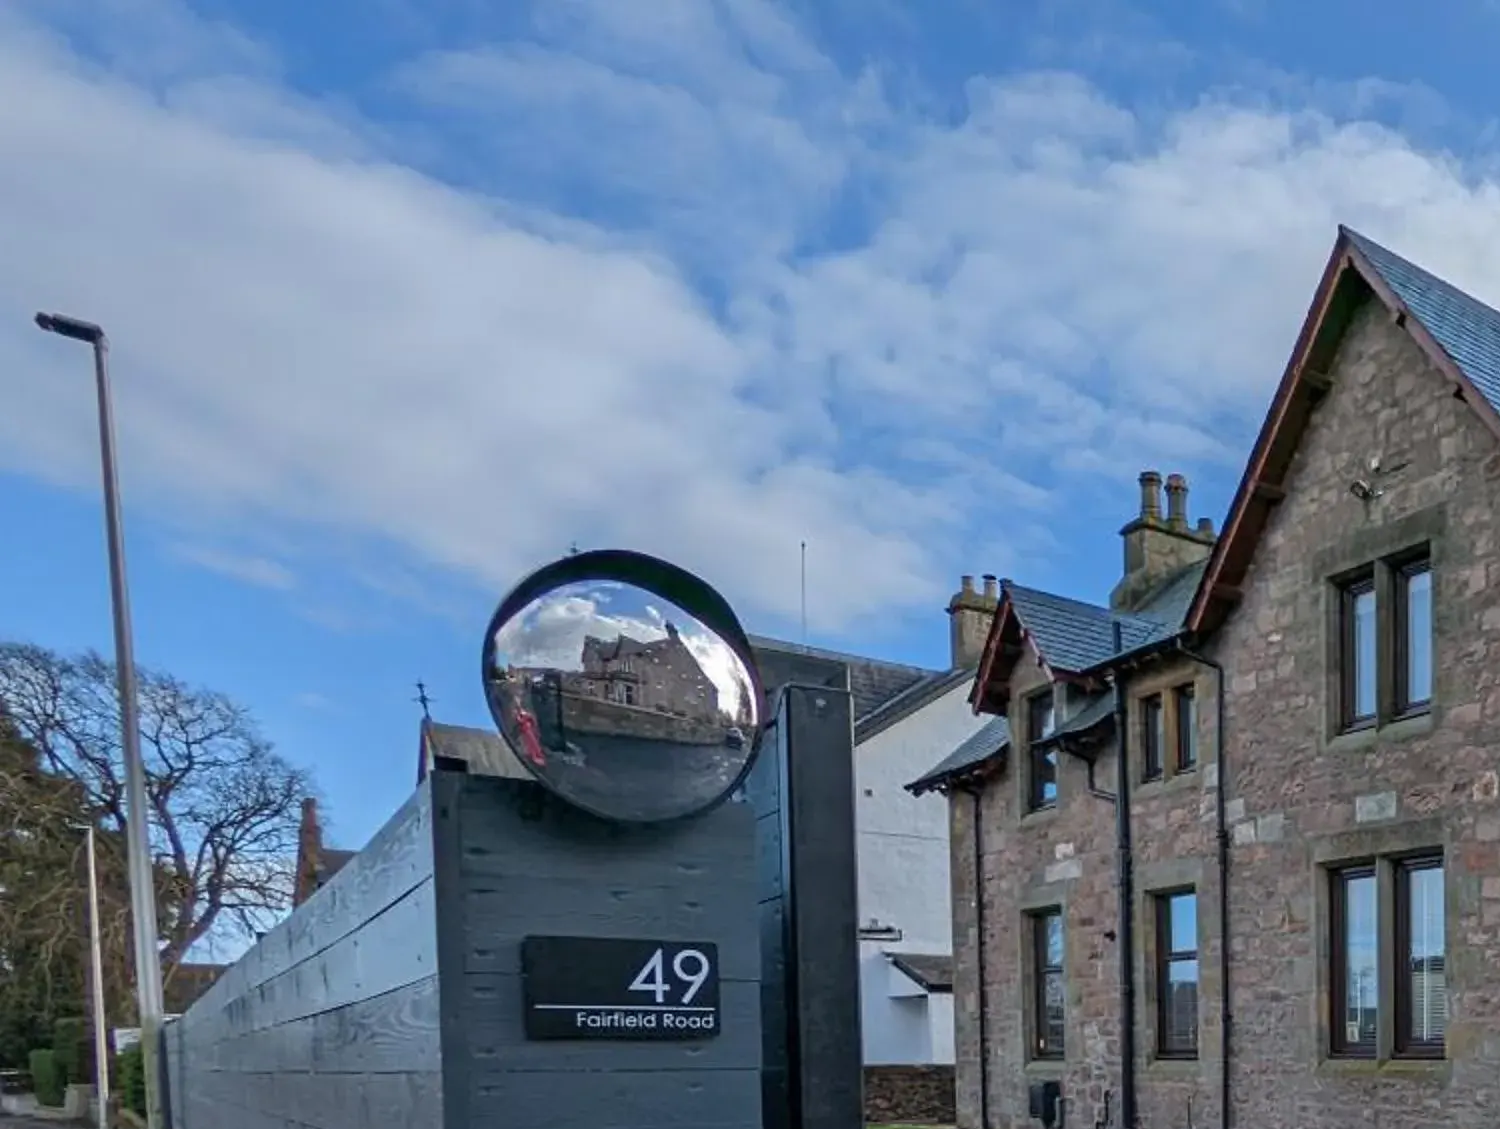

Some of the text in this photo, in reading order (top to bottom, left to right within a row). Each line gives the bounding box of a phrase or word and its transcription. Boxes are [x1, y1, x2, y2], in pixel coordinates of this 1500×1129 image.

[628, 948, 710, 1004] 49
[576, 1012, 715, 1029] Fairfield Road
